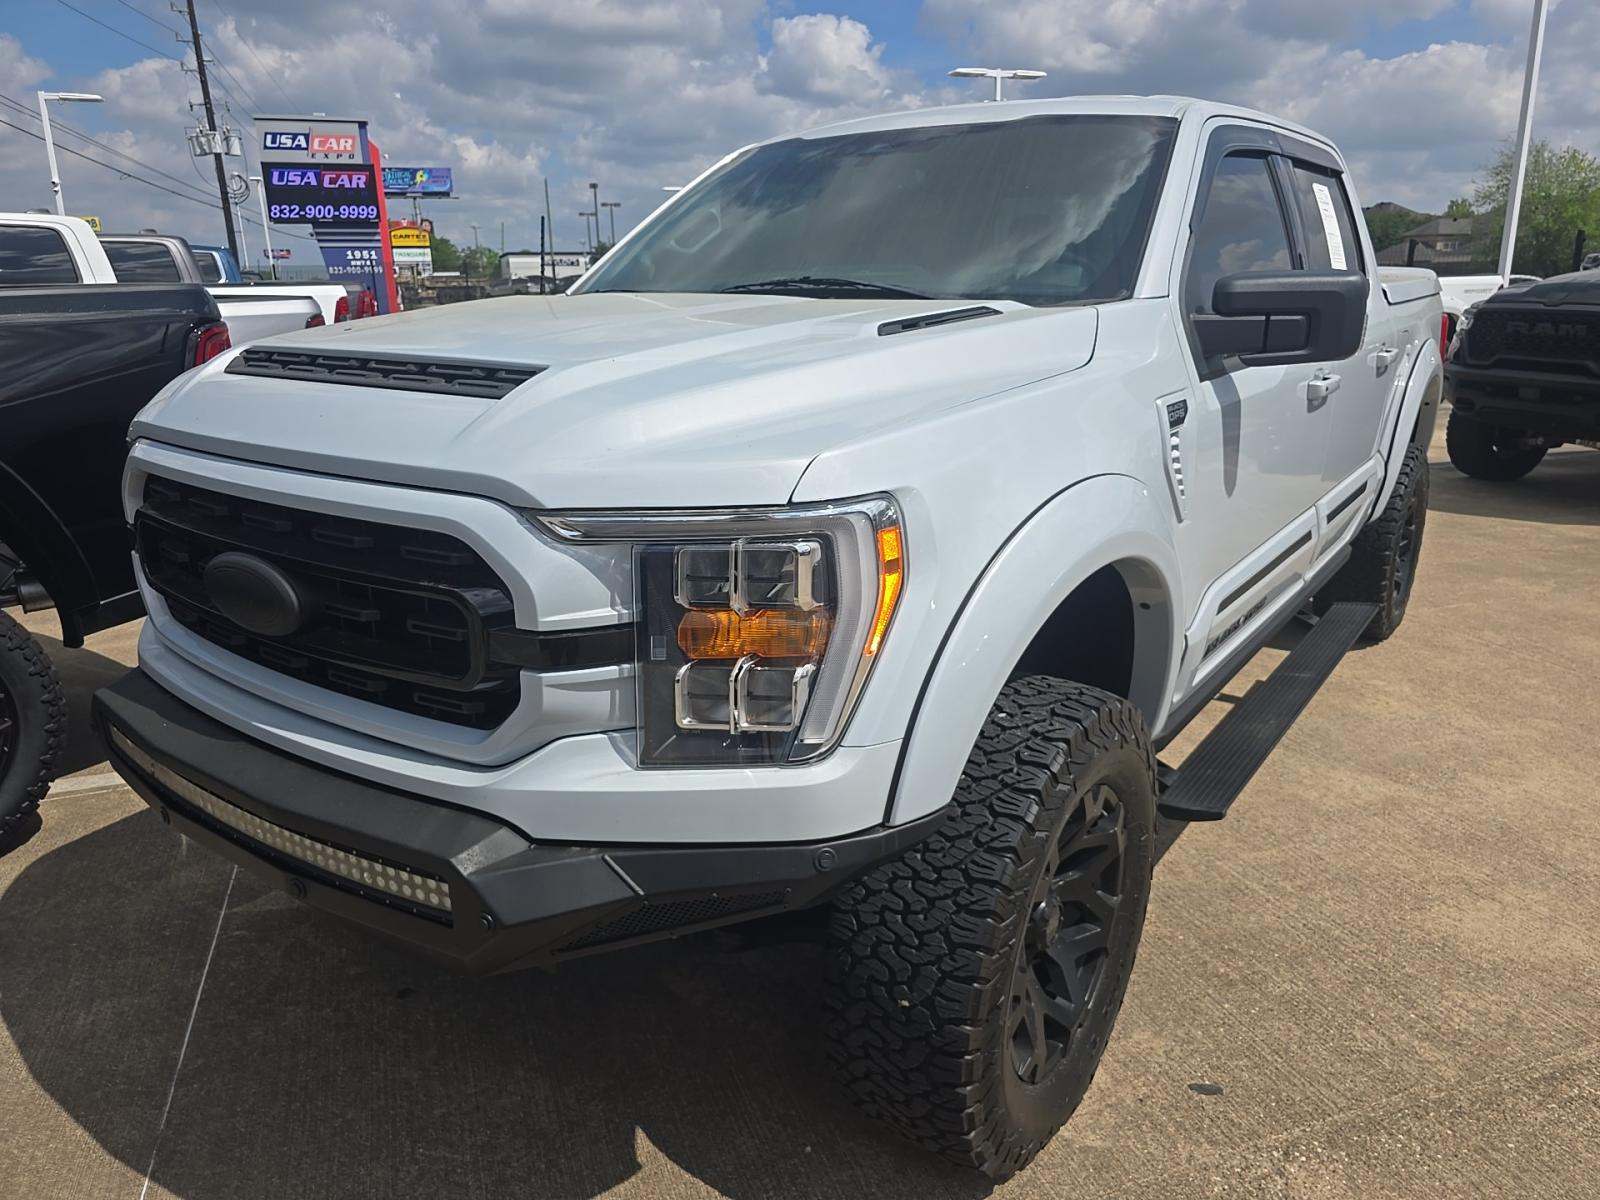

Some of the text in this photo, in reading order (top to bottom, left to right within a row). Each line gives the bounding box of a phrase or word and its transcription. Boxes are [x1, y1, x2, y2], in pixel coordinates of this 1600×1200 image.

[265, 134, 353, 151] USA CAR
[272, 170, 367, 188] USA CAR
[270, 204, 377, 219] 832-900-9999
[346, 250, 378, 259] 1951
[1169, 408, 1185, 421] OPS
